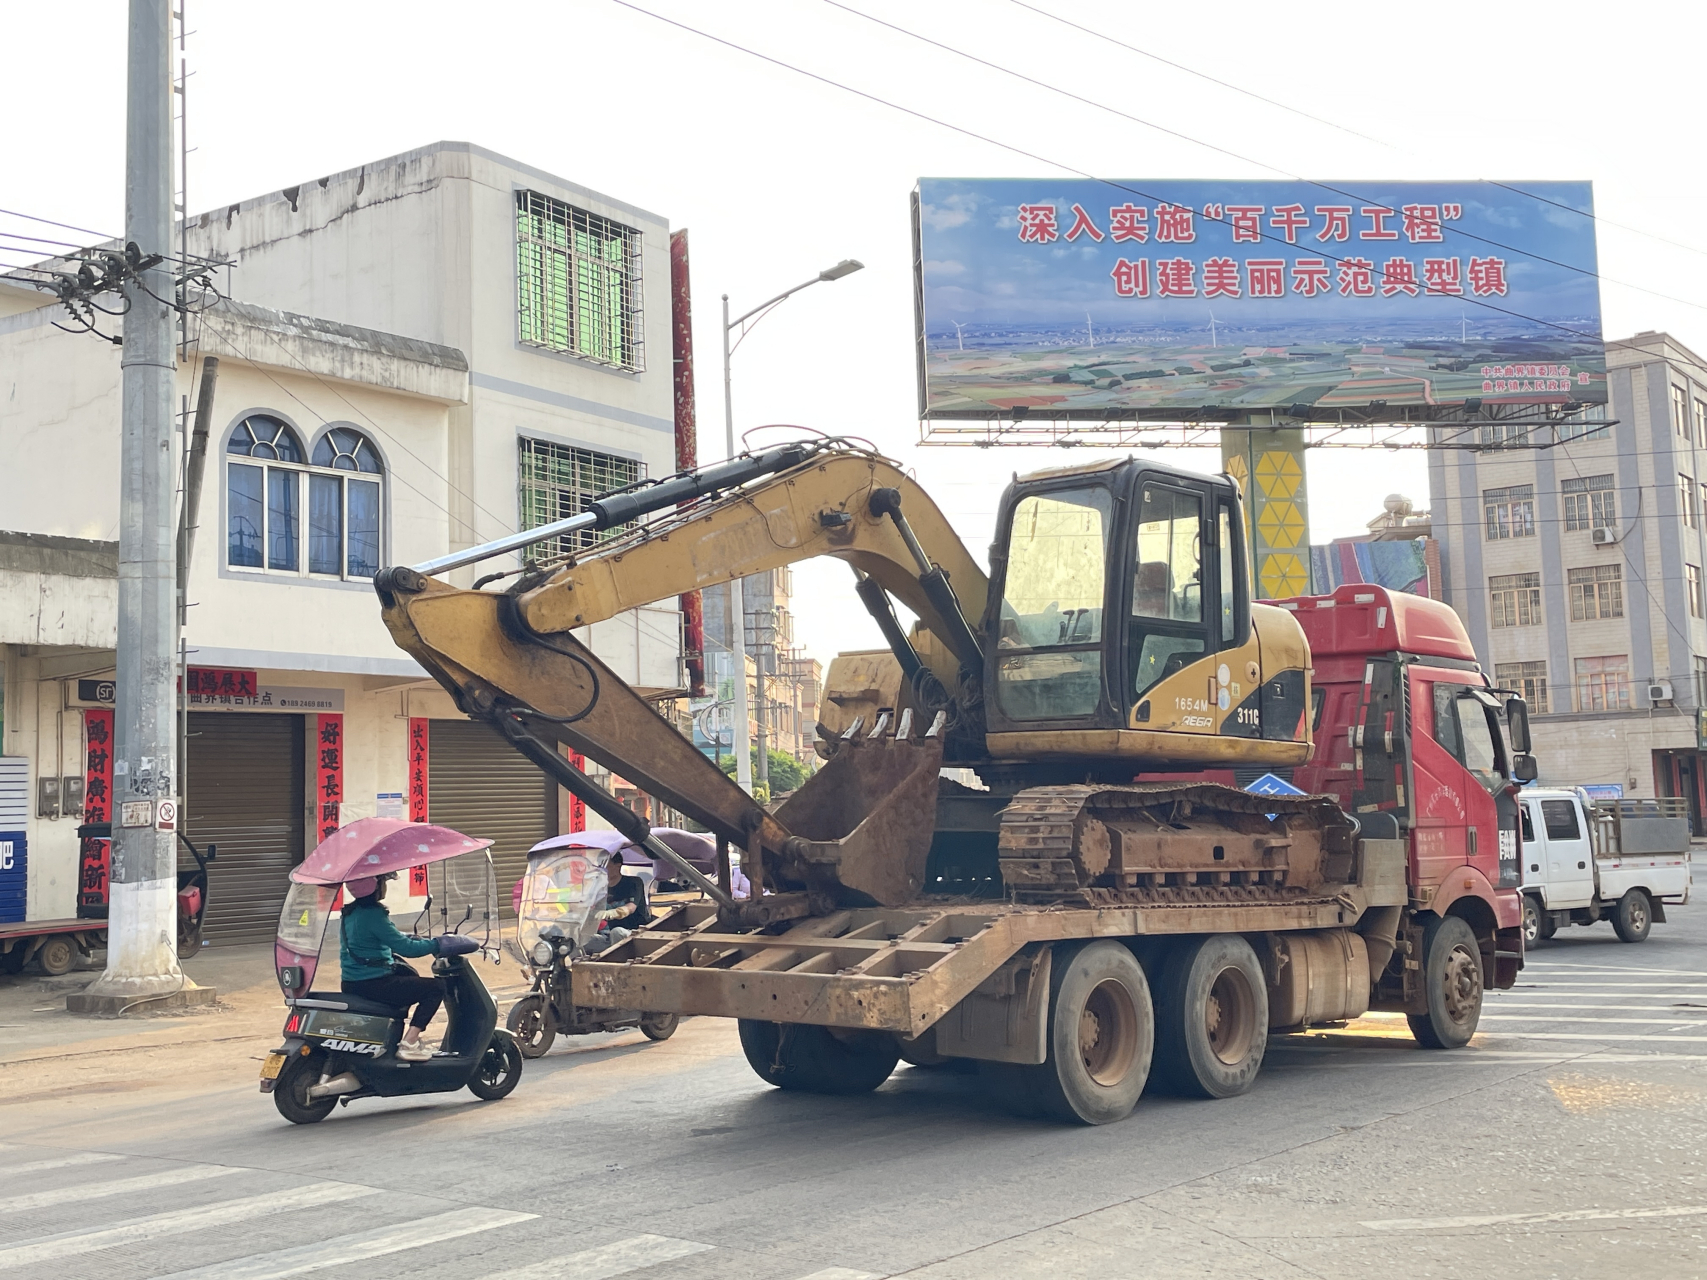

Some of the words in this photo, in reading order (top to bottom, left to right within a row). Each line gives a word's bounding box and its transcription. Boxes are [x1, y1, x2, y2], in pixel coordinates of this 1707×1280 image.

[1018, 203, 1462, 244] 深入实施“百千万工程”
[1110, 256, 1508, 298] 创建美丽示范典型镇
[1481, 365, 1570, 377] 中共曲界镇委员会
[1578, 372, 1590, 384] 宣
[1482, 380, 1571, 392] 曲界镇人民政府
[320, 1038, 388, 1059] AIMA
